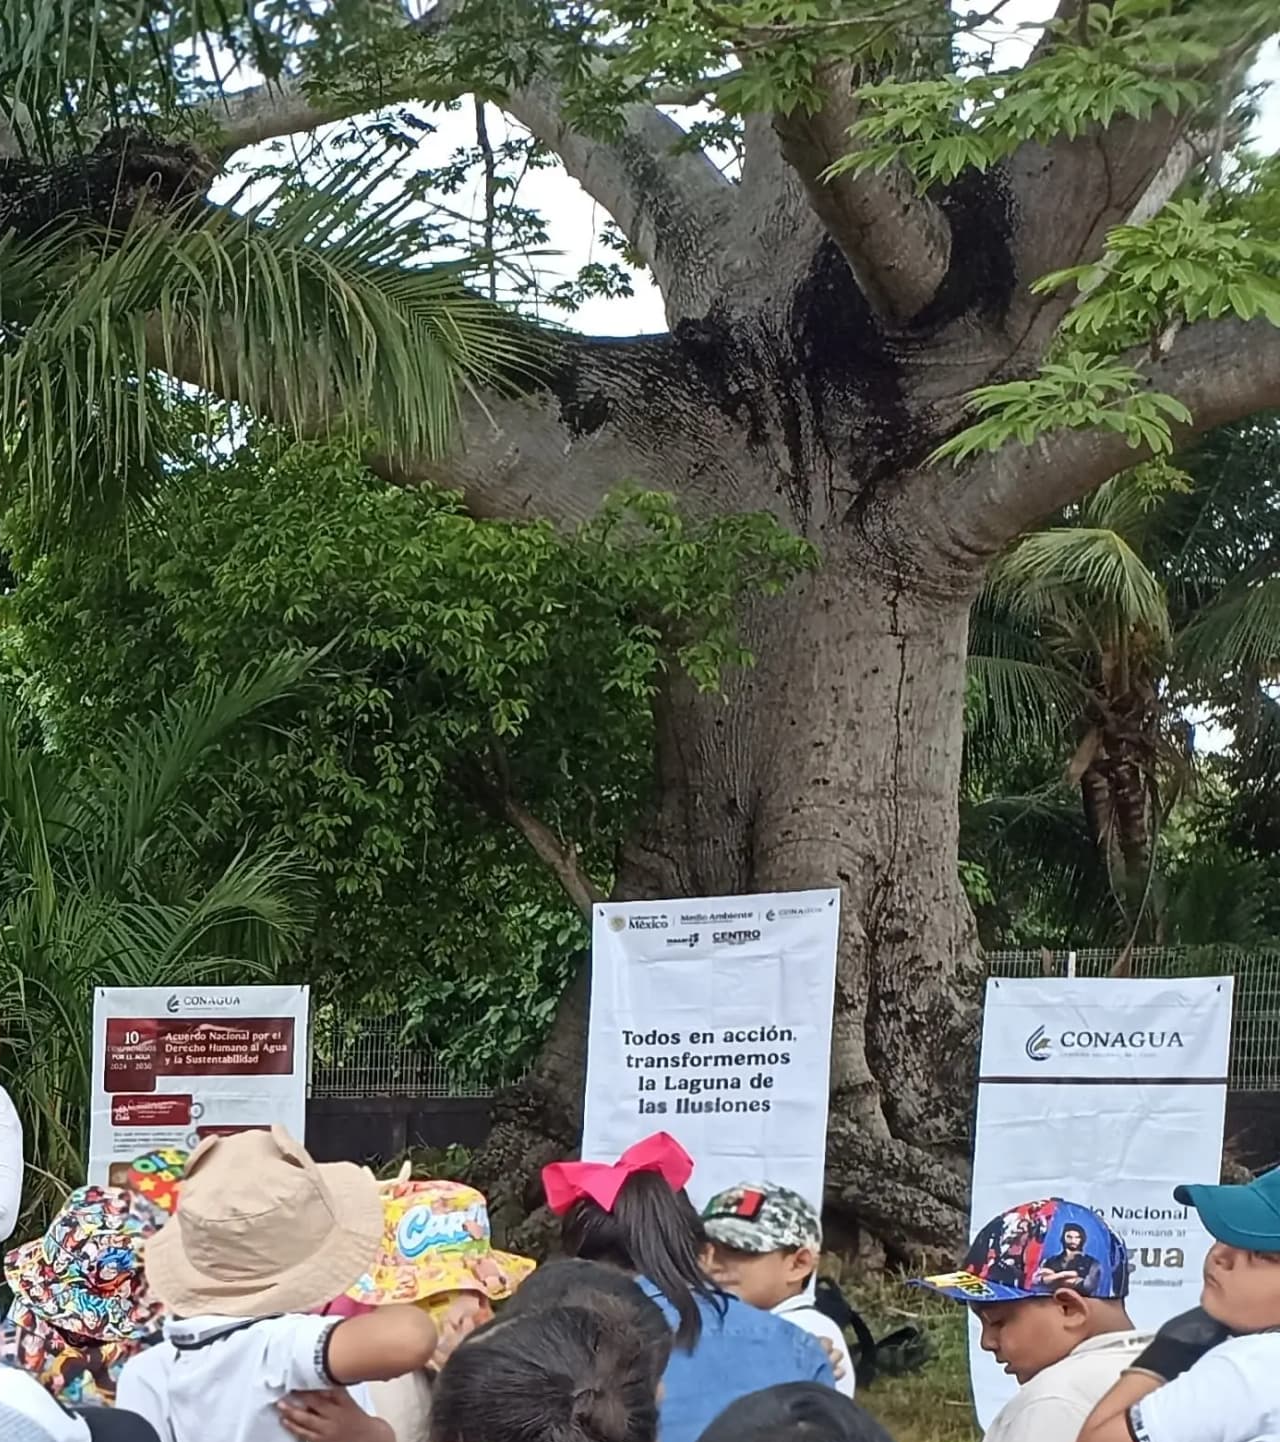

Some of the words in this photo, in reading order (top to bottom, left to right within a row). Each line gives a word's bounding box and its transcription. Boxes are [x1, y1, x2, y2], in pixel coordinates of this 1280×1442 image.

[629, 918, 668, 929] México
[712, 930, 761, 942] CENTRO
[183, 996, 240, 1006] CONAGUA
[125, 1031, 139, 1044] 10
[165, 1032, 206, 1041] Acuerdo
[209, 1031, 250, 1040] Nacional
[252, 1033, 269, 1042] por
[272, 1031, 281, 1040] el
[622, 1029, 680, 1046] Todos
[689, 1031, 715, 1044] en
[1060, 1031, 1184, 1048] CONAGUA
[165, 1043, 206, 1053] Derecho
[209, 1043, 248, 1052] Humano
[250, 1043, 260, 1052] al
[263, 1043, 288, 1054] Agua
[165, 1057, 171, 1065] y
[174, 1055, 183, 1064] la
[186, 1054, 259, 1064] Sustentabilidad
[626, 1051, 791, 1069] transformemos
[638, 1075, 656, 1091] la
[665, 1075, 741, 1094] Laguna
[750, 1073, 774, 1088] de
[638, 1098, 667, 1114] las
[676, 1098, 771, 1114] Ilusiones
[1112, 1205, 1188, 1220] Nacional
[1127, 1247, 1184, 1273] gua
